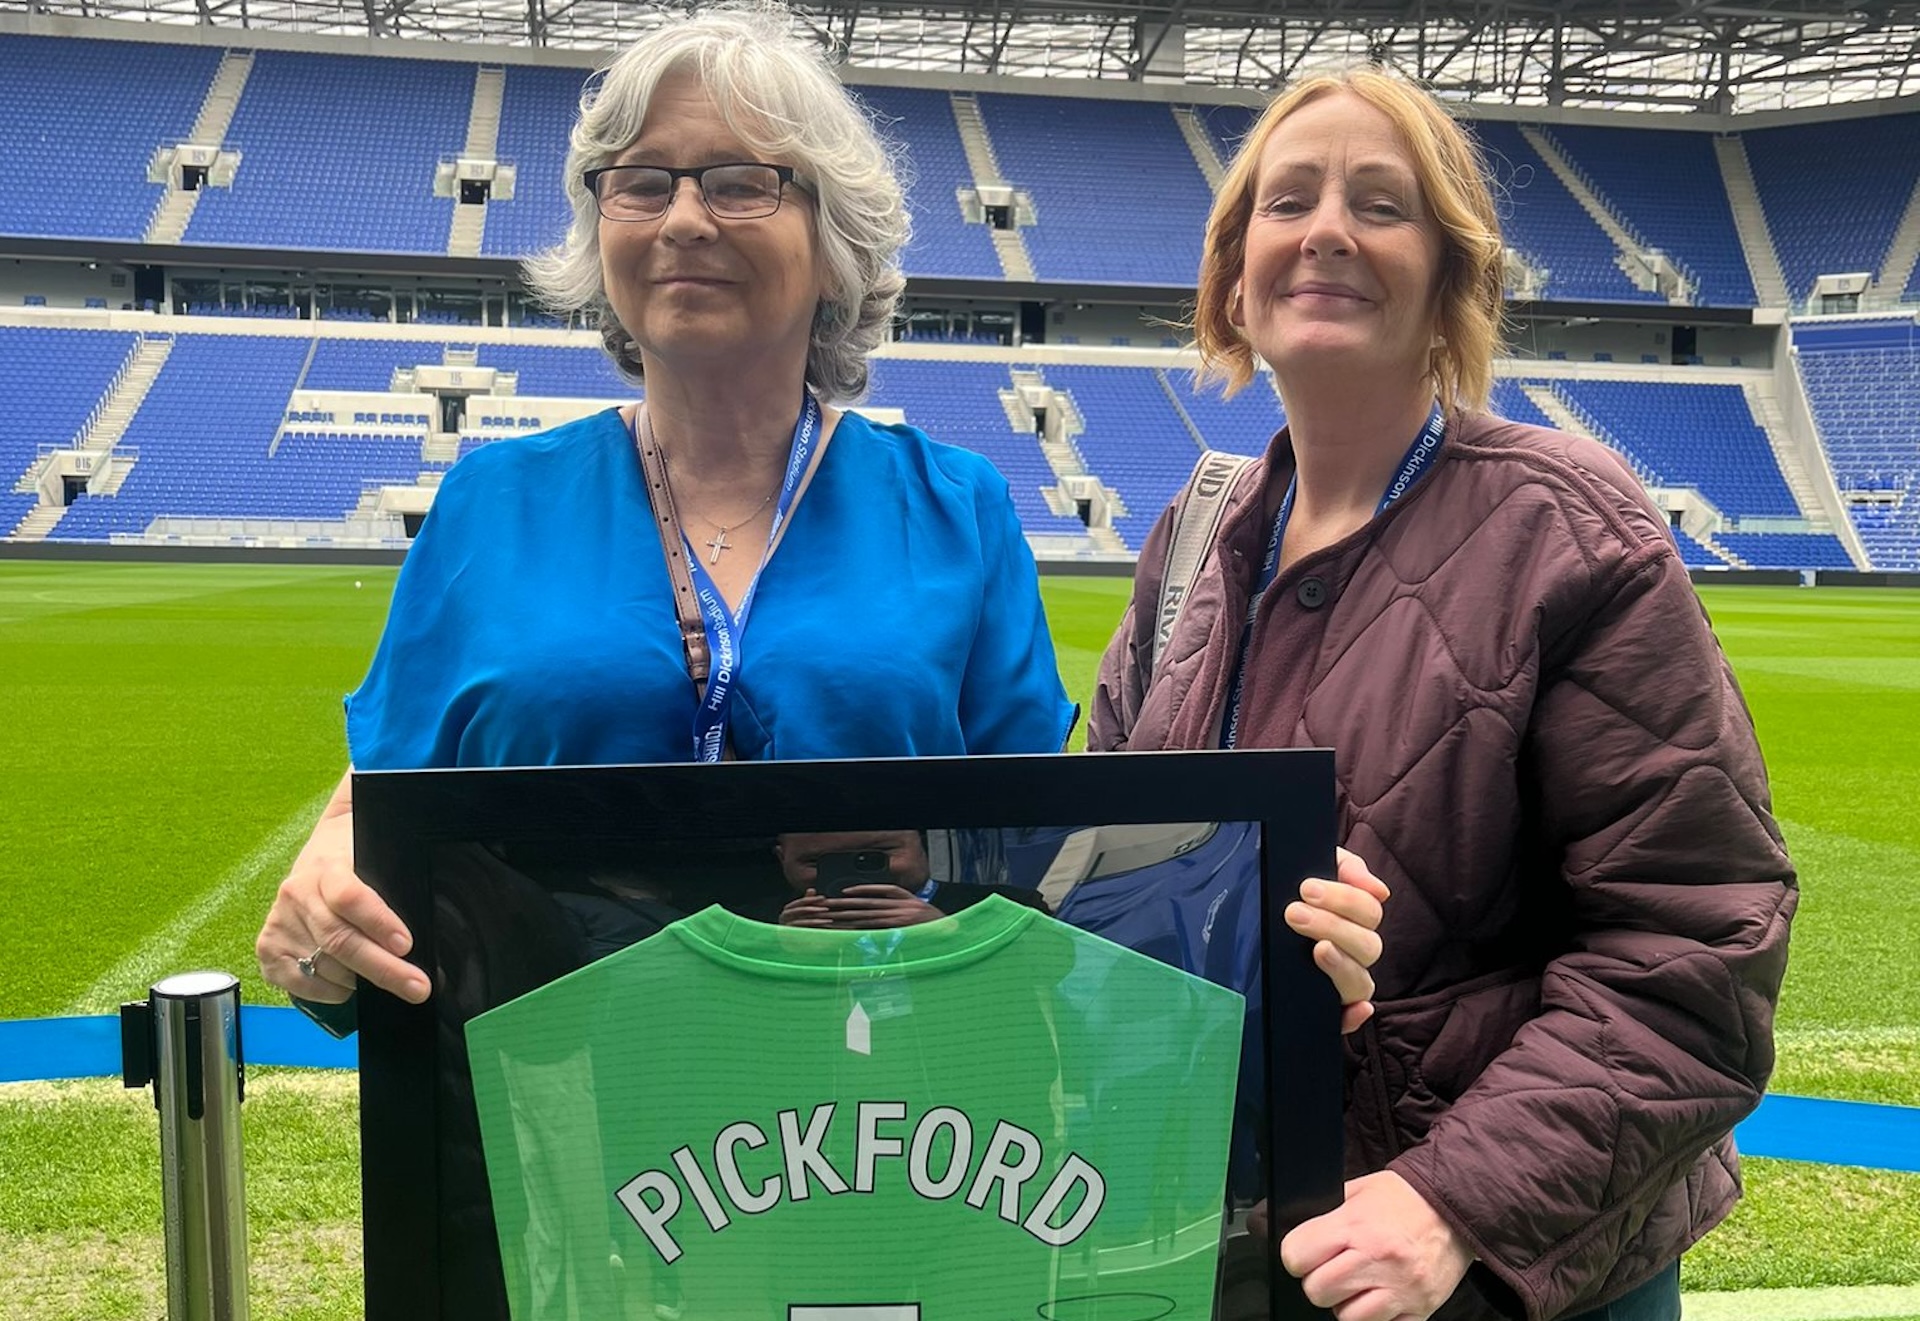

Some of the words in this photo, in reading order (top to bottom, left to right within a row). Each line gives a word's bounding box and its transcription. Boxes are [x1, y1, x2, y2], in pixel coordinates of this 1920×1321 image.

[1429, 414, 1445, 436] Hill
[786, 443, 808, 492] Stadium
[1389, 434, 1437, 500] Dickinson
[1261, 550, 1276, 571] Hill
[700, 588, 727, 630] Stadium
[717, 629, 734, 685] Dickinson
[708, 687, 726, 711] Hill
[614, 1099, 1108, 1266] PICKFORD
